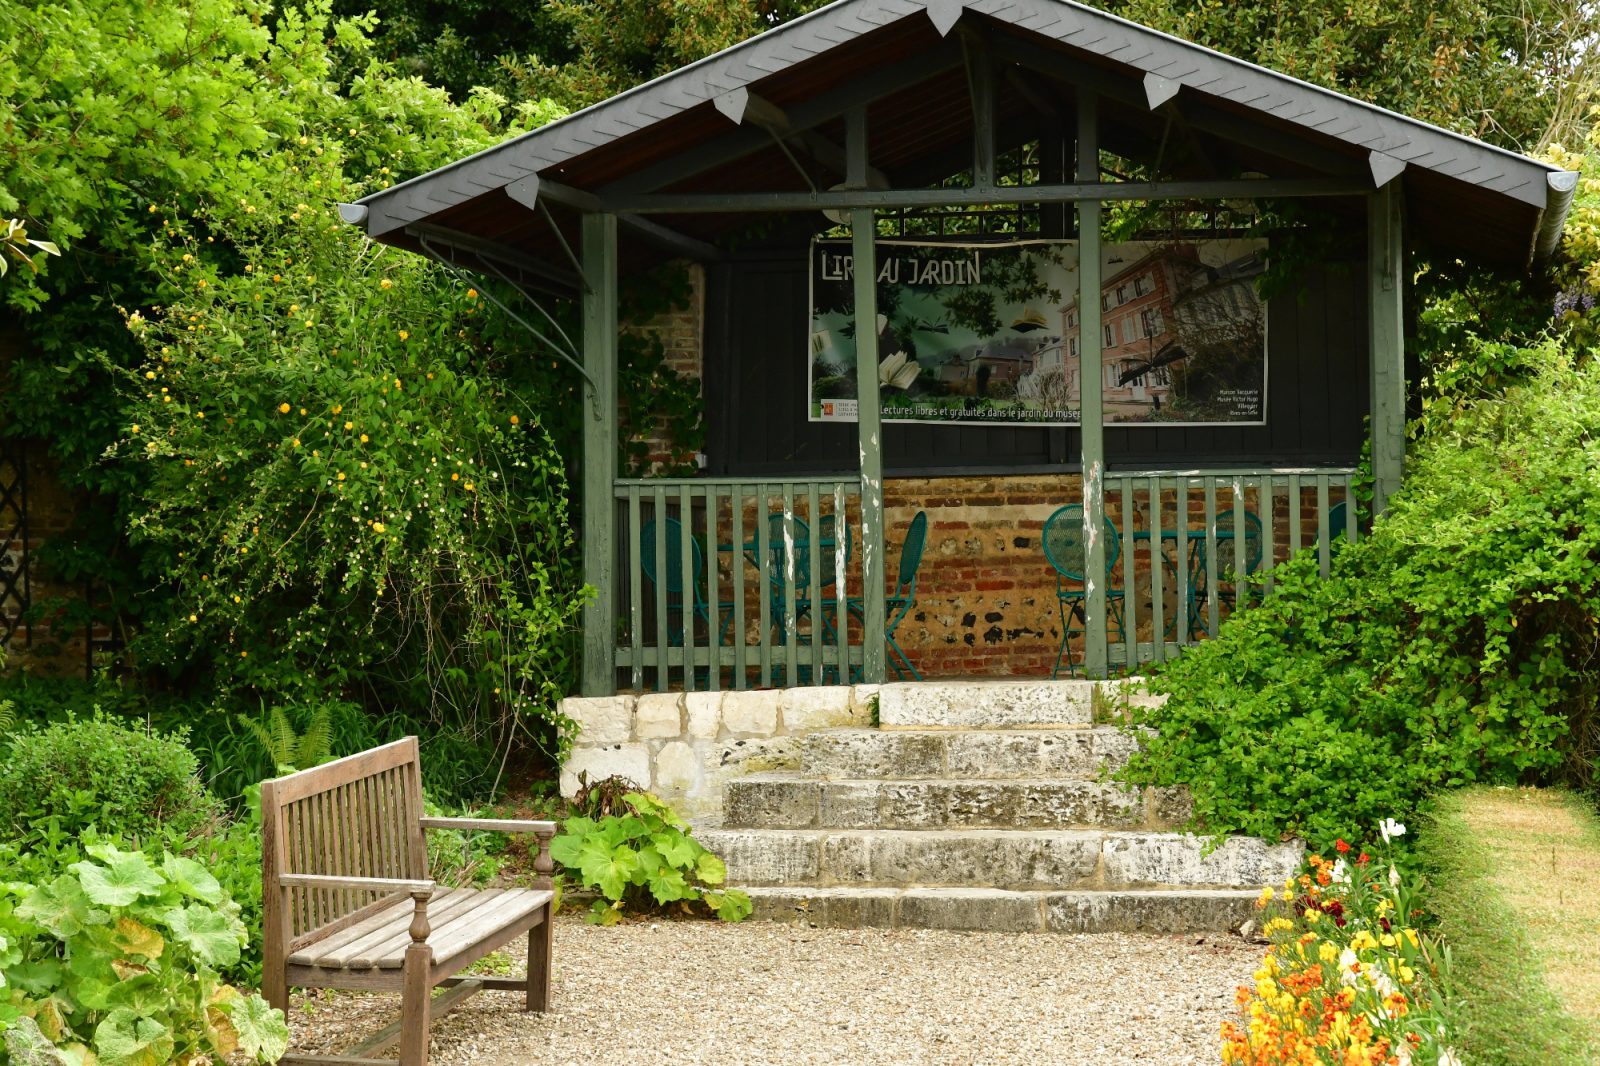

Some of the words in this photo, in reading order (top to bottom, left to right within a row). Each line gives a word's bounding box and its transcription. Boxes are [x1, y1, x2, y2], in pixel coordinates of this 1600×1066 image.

[821, 252, 855, 281] LIR
[876, 256, 900, 285] AU
[907, 250, 981, 286] JARDIN
[880, 404, 914, 415] Lectures
[915, 405, 938, 416] libres
[939, 406, 948, 416] et
[949, 406, 986, 419] gratuites
[987, 407, 1007, 417] dans
[1008, 407, 1016, 417] le
[1017, 407, 1042, 420] jardin
[1043, 408, 1054, 418] du
